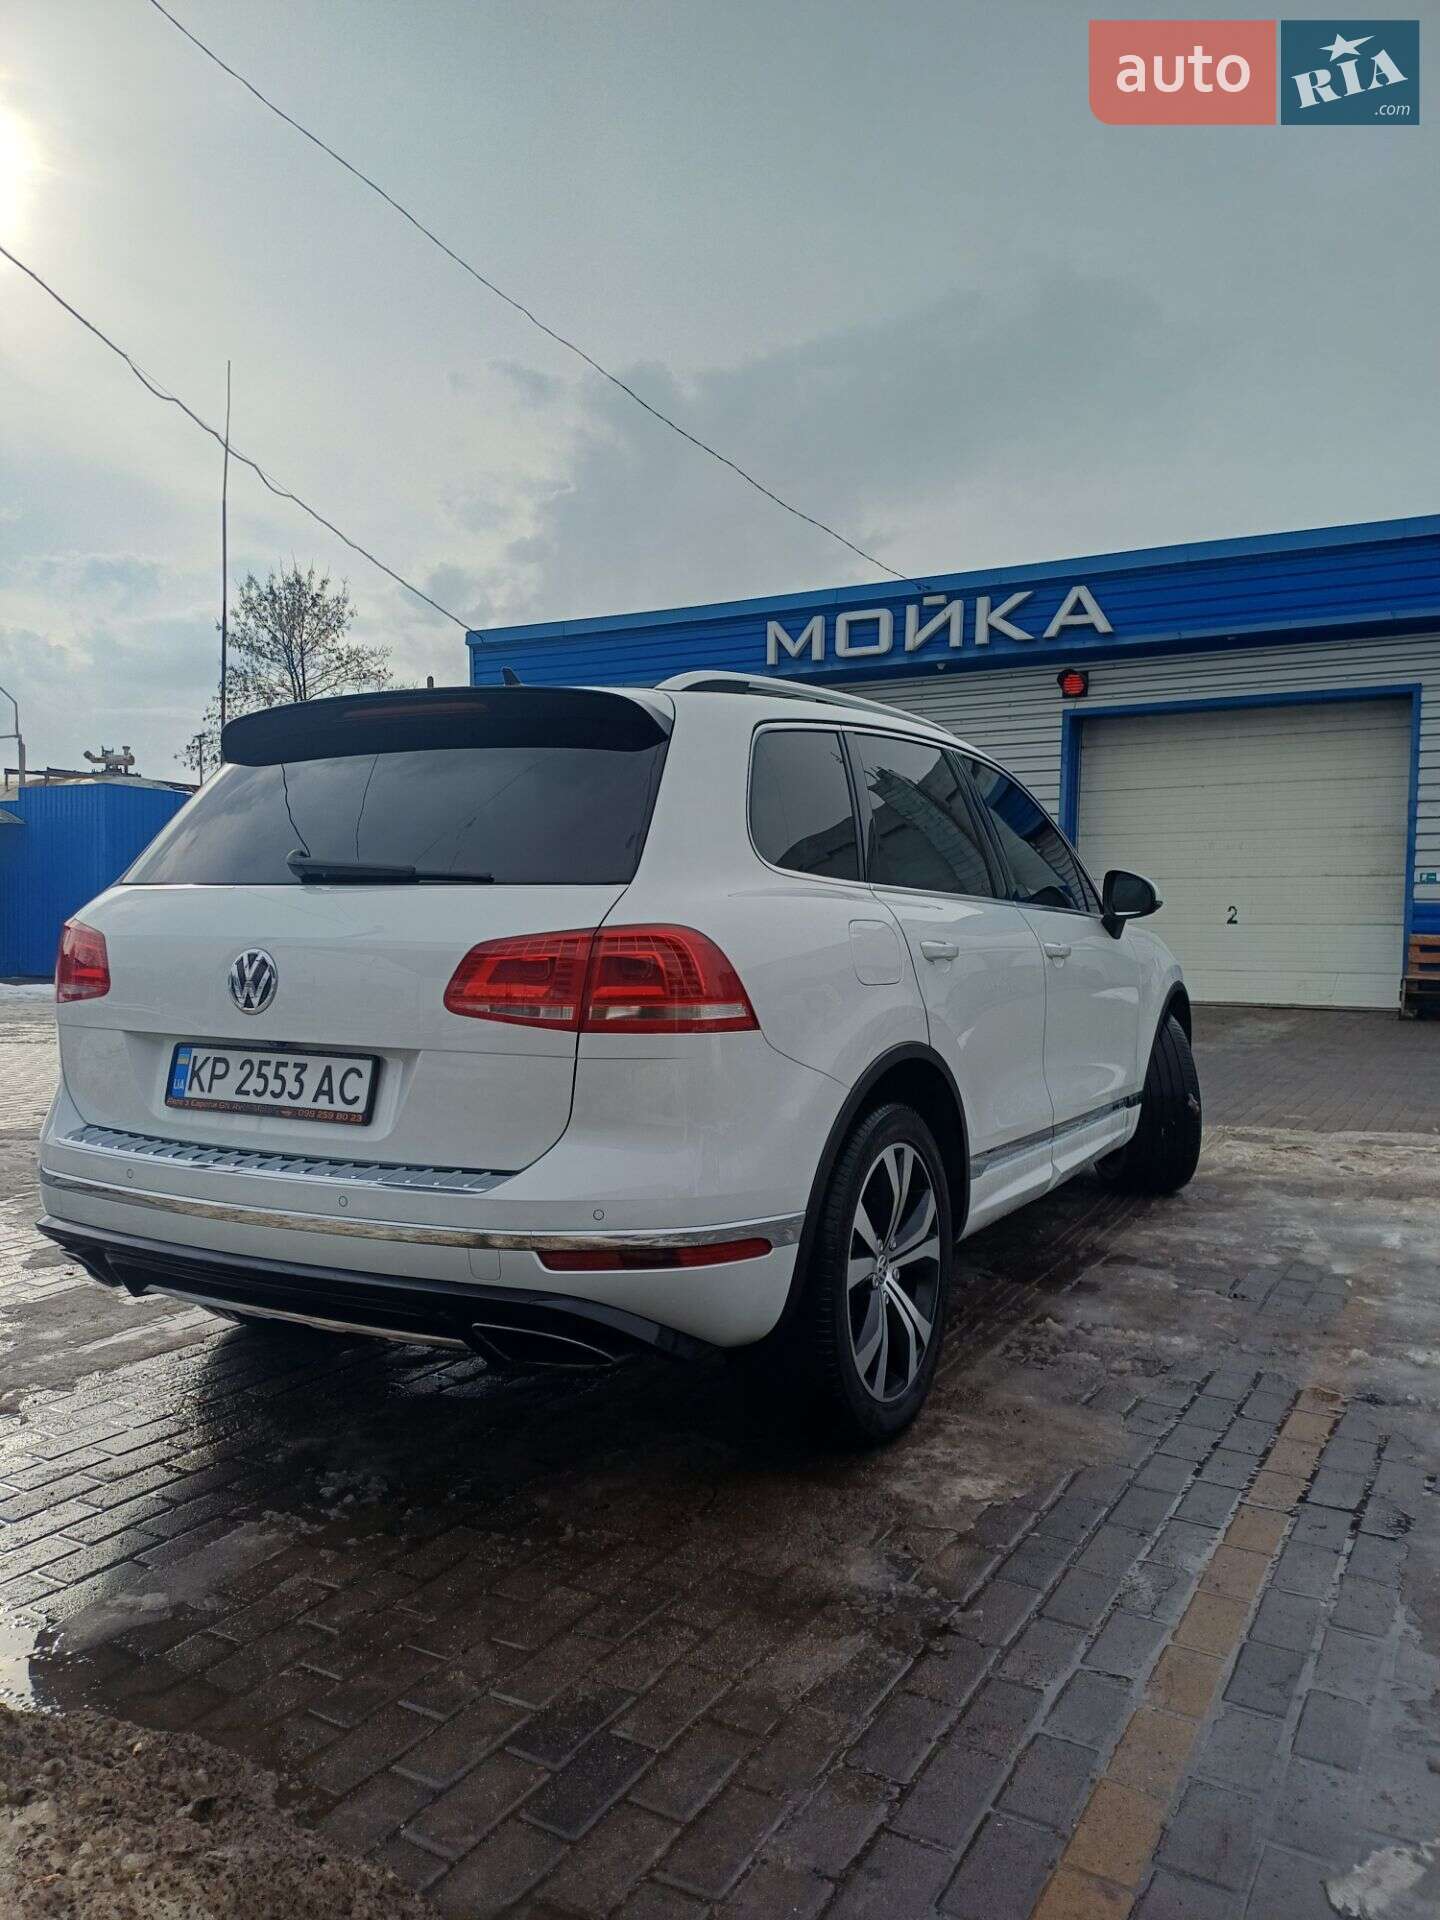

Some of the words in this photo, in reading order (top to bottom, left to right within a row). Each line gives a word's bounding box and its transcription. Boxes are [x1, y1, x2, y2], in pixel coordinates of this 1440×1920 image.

[766, 585, 1115, 666] МОЙКА
[1226, 905, 1238, 925] 2
[188, 1055, 230, 1093] KP
[235, 1058, 308, 1100] 2553
[312, 1065, 363, 1106] AC
